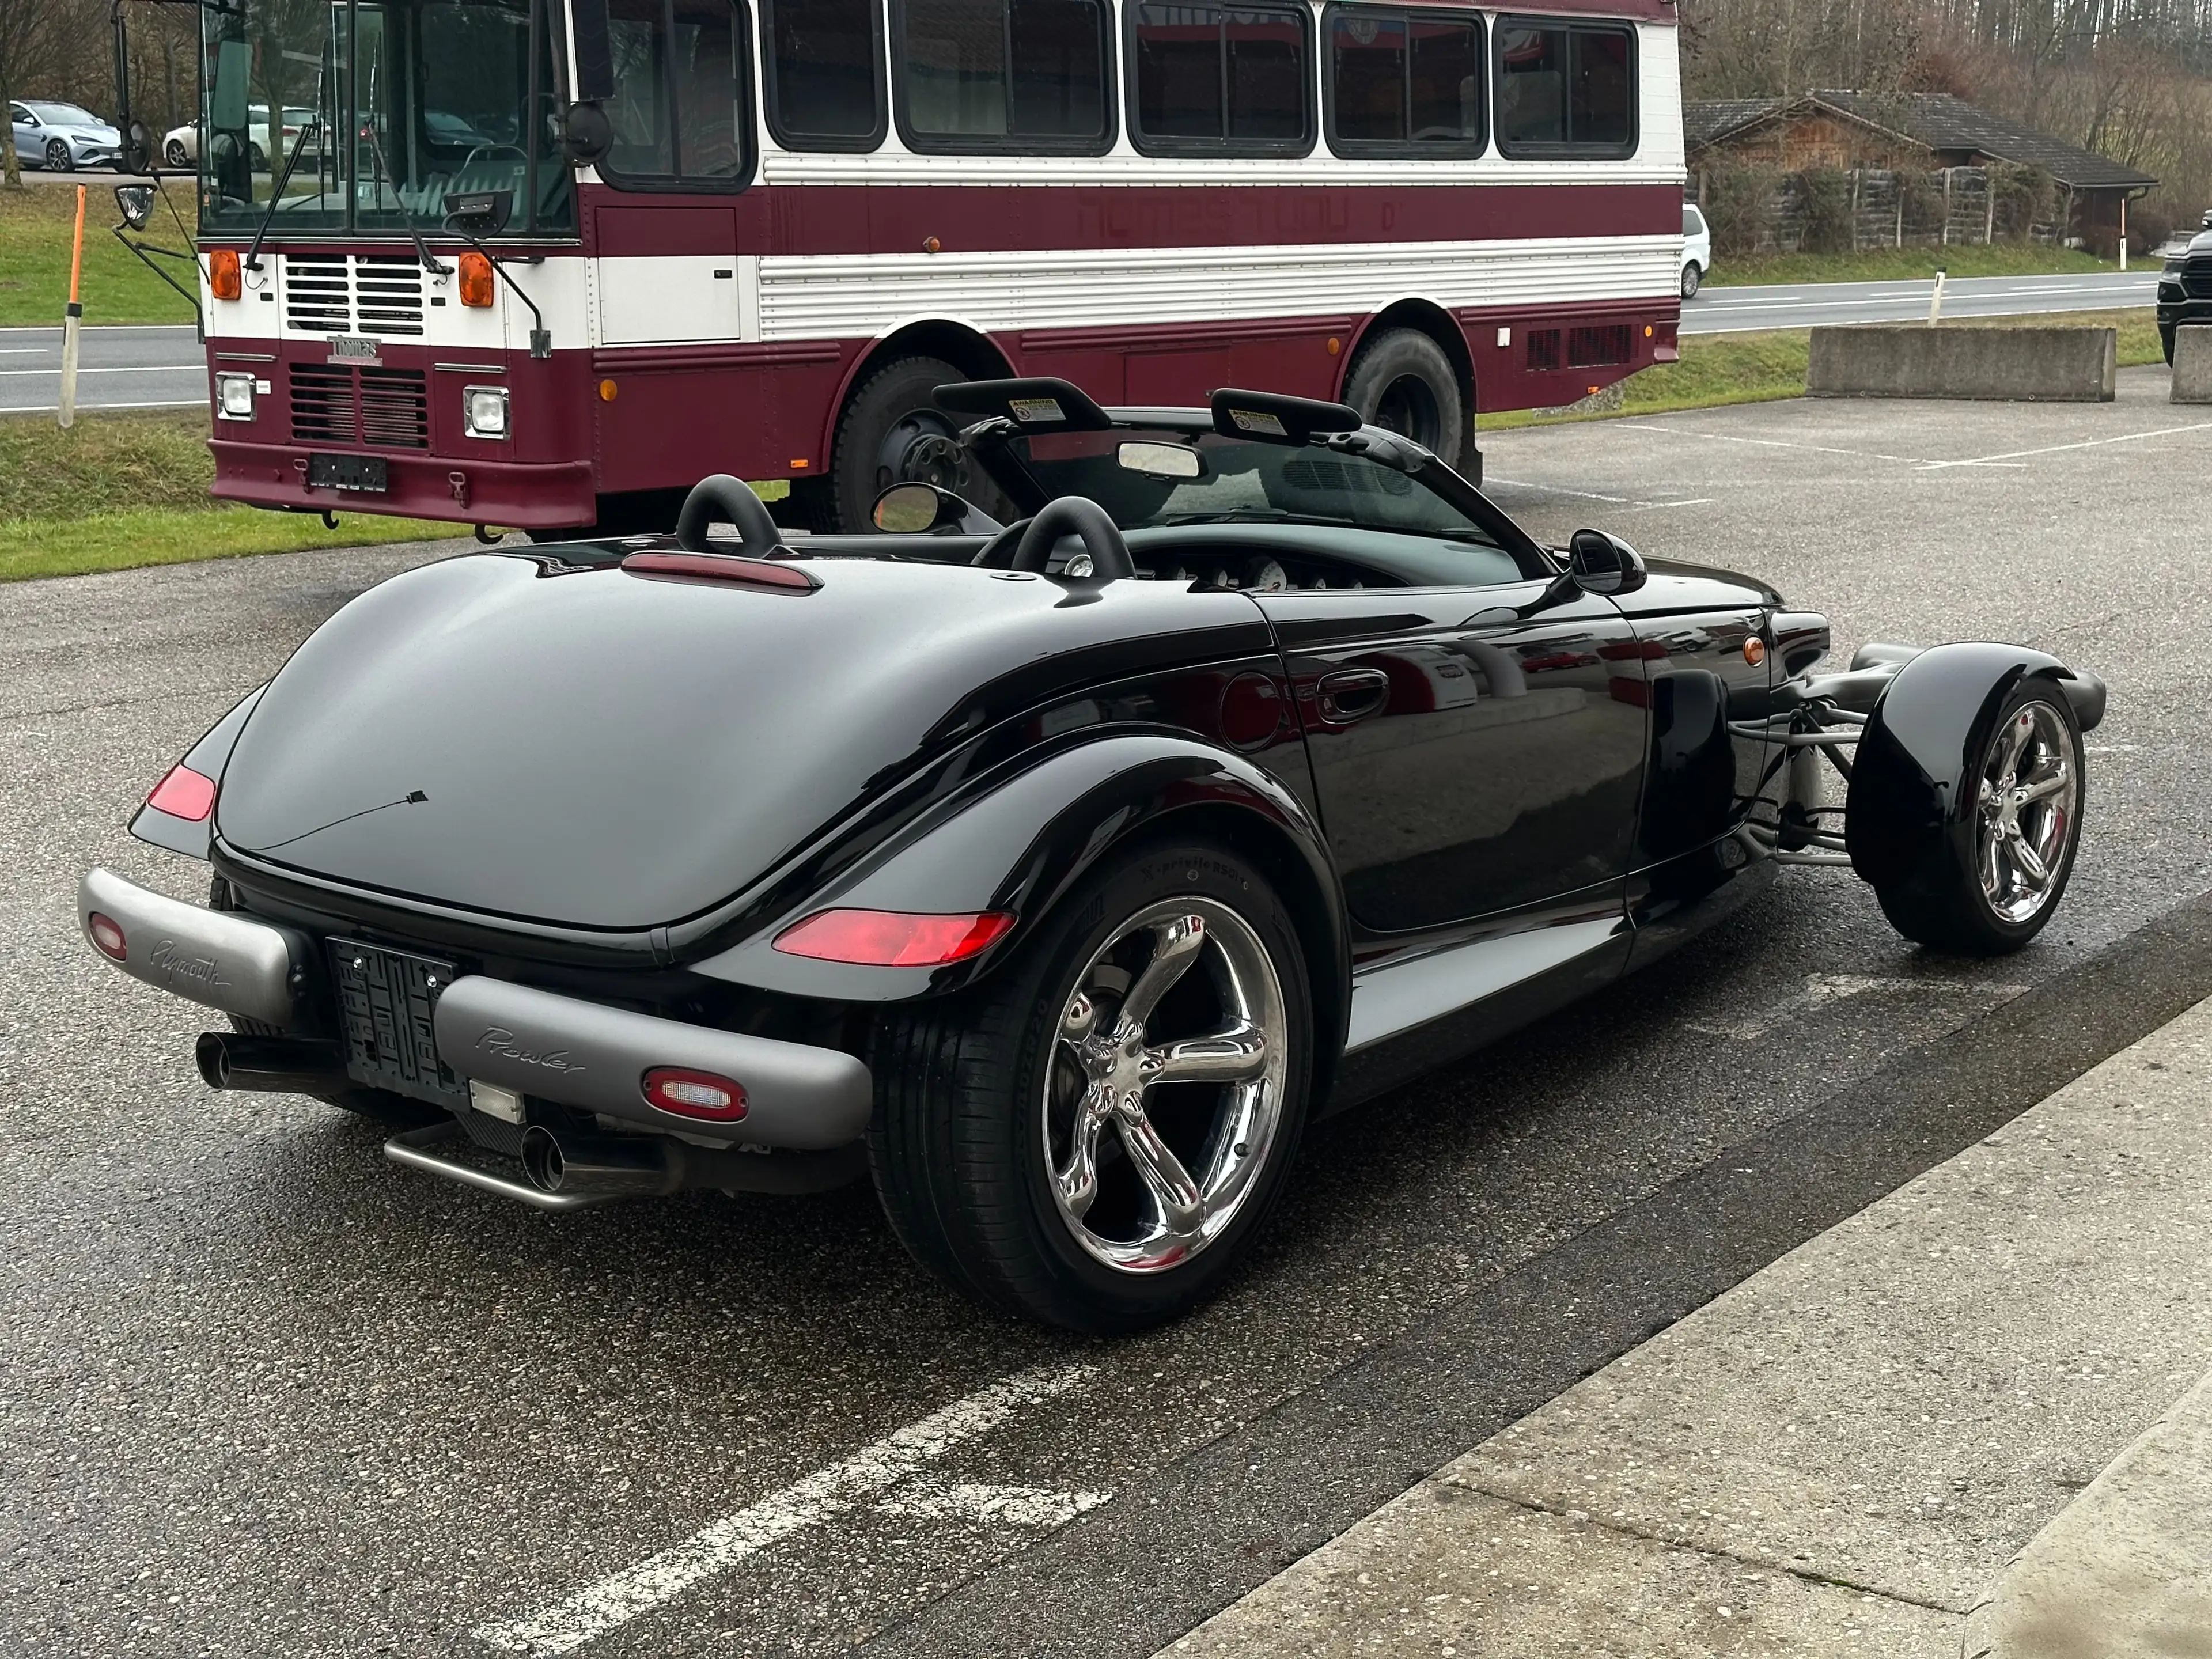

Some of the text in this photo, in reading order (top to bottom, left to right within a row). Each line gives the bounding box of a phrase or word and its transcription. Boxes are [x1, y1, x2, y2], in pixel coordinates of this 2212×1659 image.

[327, 335, 380, 358] Thomas
[150, 940, 232, 984] Plymouth
[475, 1024, 586, 1074] Prowler
